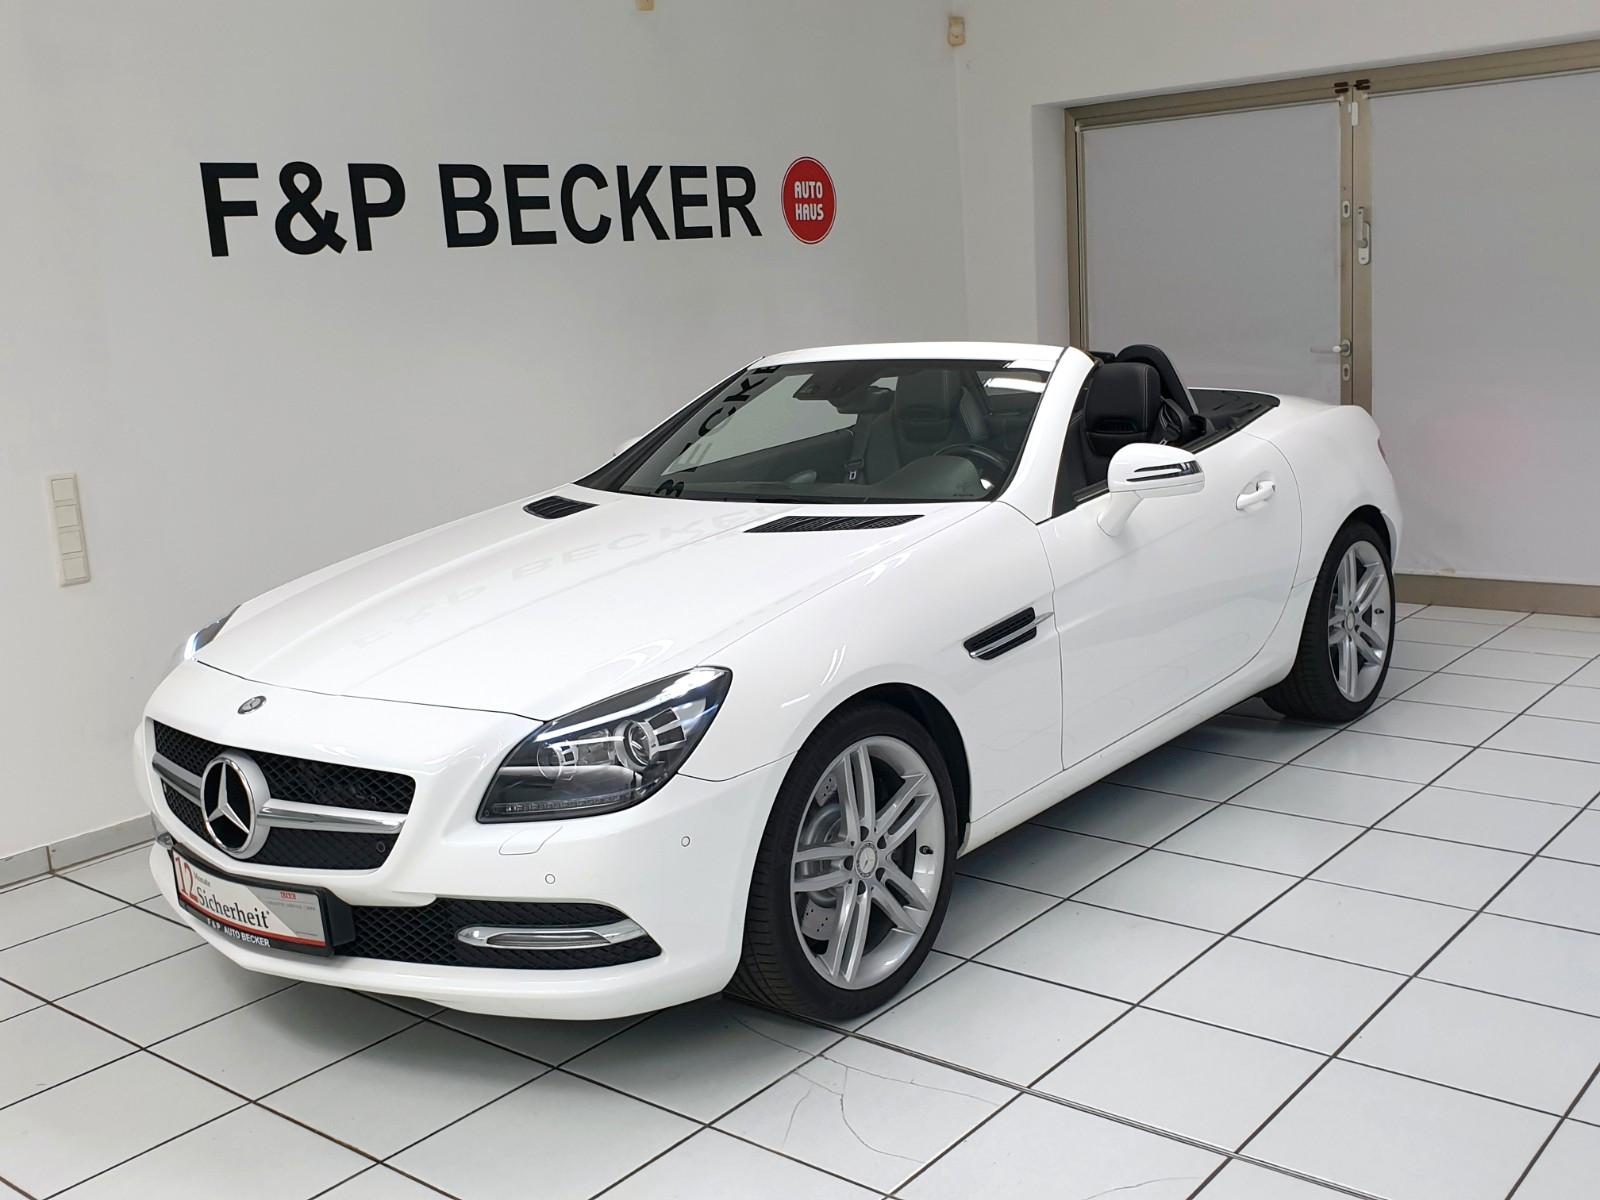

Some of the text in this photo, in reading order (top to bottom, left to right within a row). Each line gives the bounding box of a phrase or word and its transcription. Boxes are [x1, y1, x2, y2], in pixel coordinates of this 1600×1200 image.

[794, 181, 823, 199] AUTO
[200, 161, 762, 257] F&P BECKER
[795, 203, 825, 221] HAUS
[175, 857, 198, 903] 12
[224, 925, 240, 939] AUTO
[241, 932, 270, 947] BECKER
